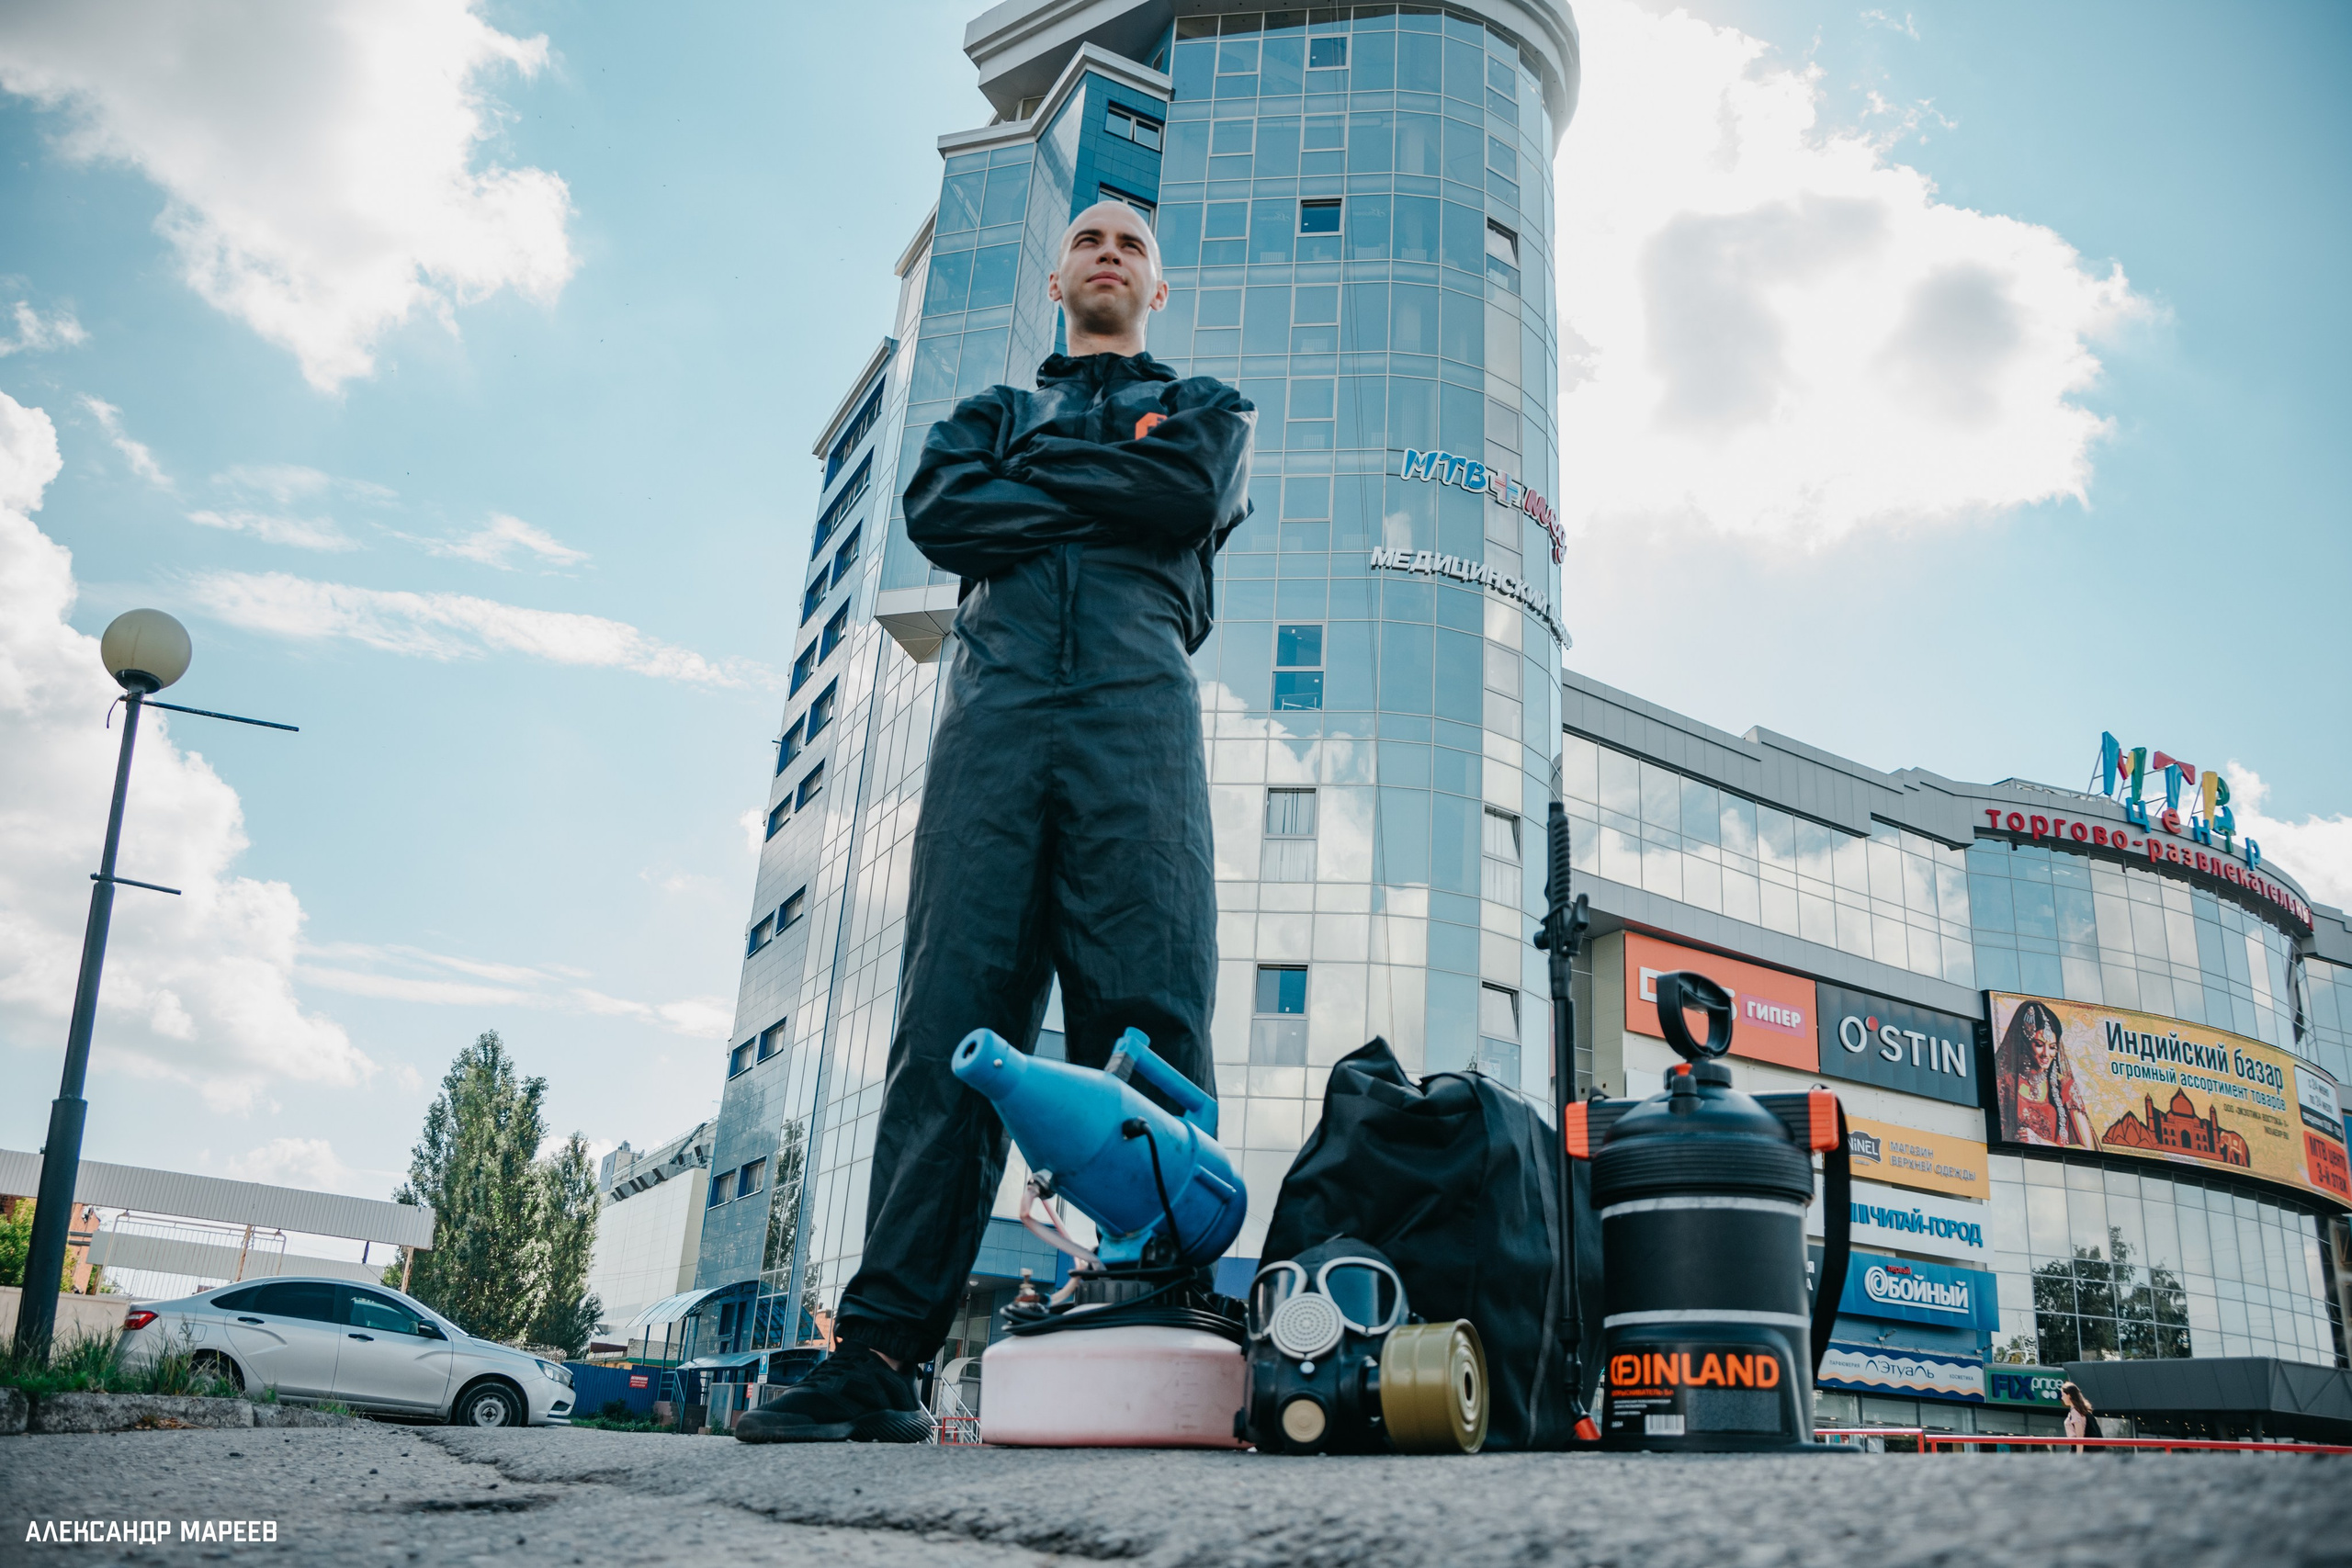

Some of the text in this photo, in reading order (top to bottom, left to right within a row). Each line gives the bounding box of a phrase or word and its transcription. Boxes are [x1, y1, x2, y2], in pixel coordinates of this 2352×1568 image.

[1400, 447, 1487, 493] МТВ
[1370, 546, 1548, 617] МЕДИЦИНСКИЙ
[2101, 730, 2236, 837] МТВ
[1747, 999, 1802, 1029] ГИПЕР
[2105, 1020, 2285, 1095] Индийский базар
[2110, 1060, 2287, 1112] огромный ассортимент товаров
[1889, 1140, 1935, 1158] МАГАЗИН
[1890, 1155, 1933, 1173] ВЕРХНЕЙ
[1934, 1164, 1977, 1182] ОДЕЖДЫ
[2309, 1135, 2327, 1162] МТВ
[1870, 1206, 1984, 1248] ЧИТАЙ-ГОРОД
[1991, 1373, 2036, 1401] FIX
